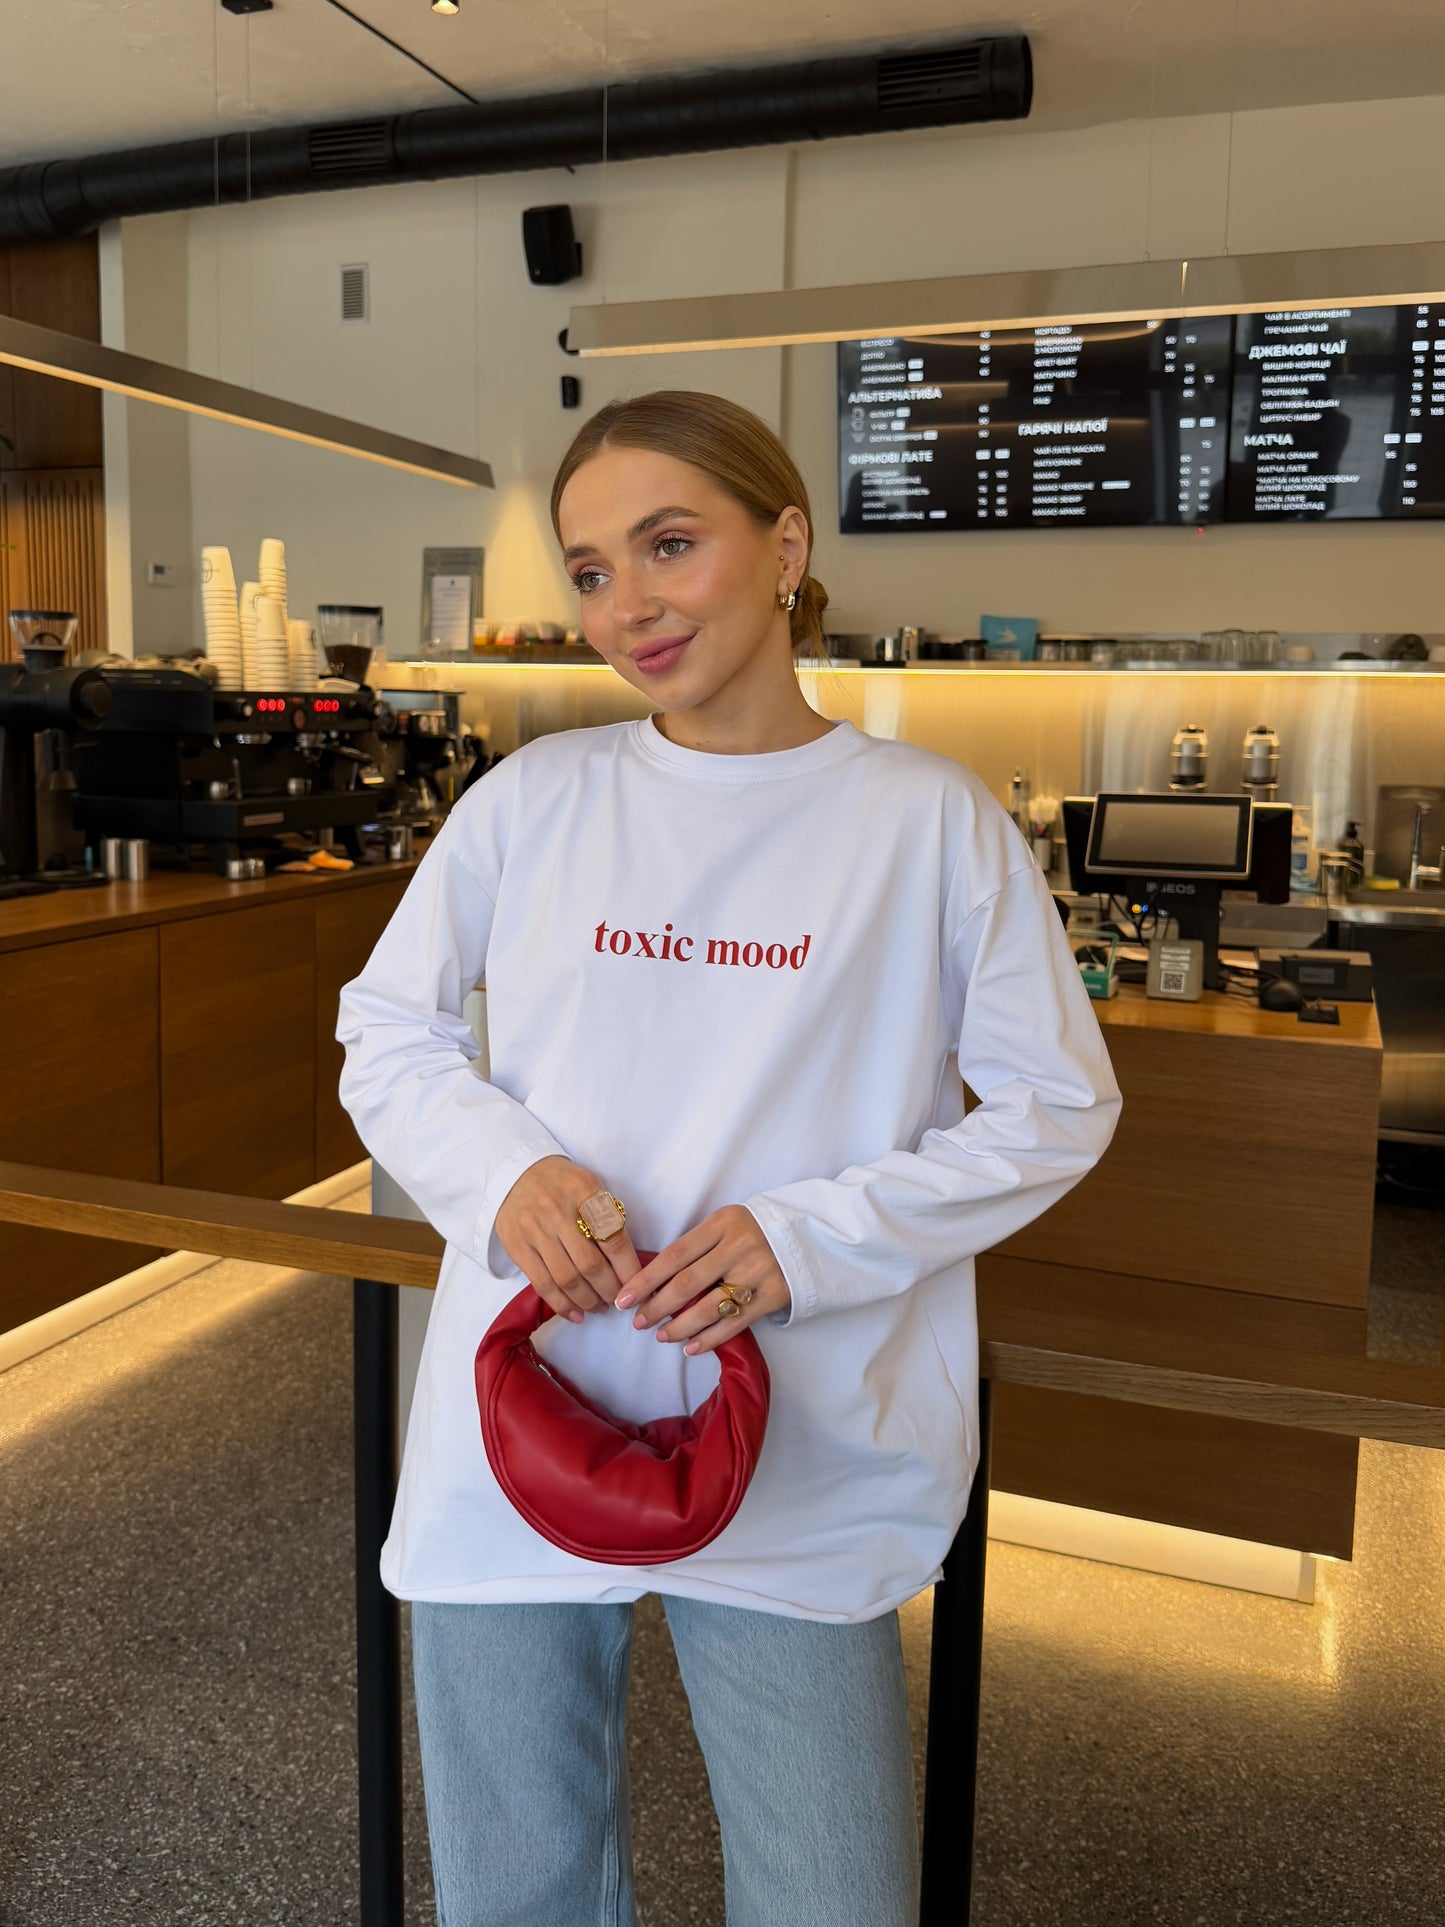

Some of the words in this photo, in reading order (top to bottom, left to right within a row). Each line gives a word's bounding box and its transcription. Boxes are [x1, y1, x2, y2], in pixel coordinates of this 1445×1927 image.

[1248, 343, 1318, 360] ДЖЕМОВІ
[1320, 339, 1348, 355] ЧАЇ
[848, 386, 943, 404] АЛЬТЕРНАТИВА
[1018, 421, 1062, 436] ГАРЯЧІ
[1063, 417, 1109, 433] НАПОЇ
[1244, 433, 1294, 447] МАТЧА
[849, 451, 900, 465] ФІРМОВІ
[901, 450, 934, 463] ЛАТЕ
[1257, 452, 1286, 461] МАТЧА
[1257, 464, 1285, 474] МАТЧА
[1286, 463, 1309, 473] ЛАТЕ
[594, 920, 694, 962] toxic
[705, 934, 812, 970] mood
